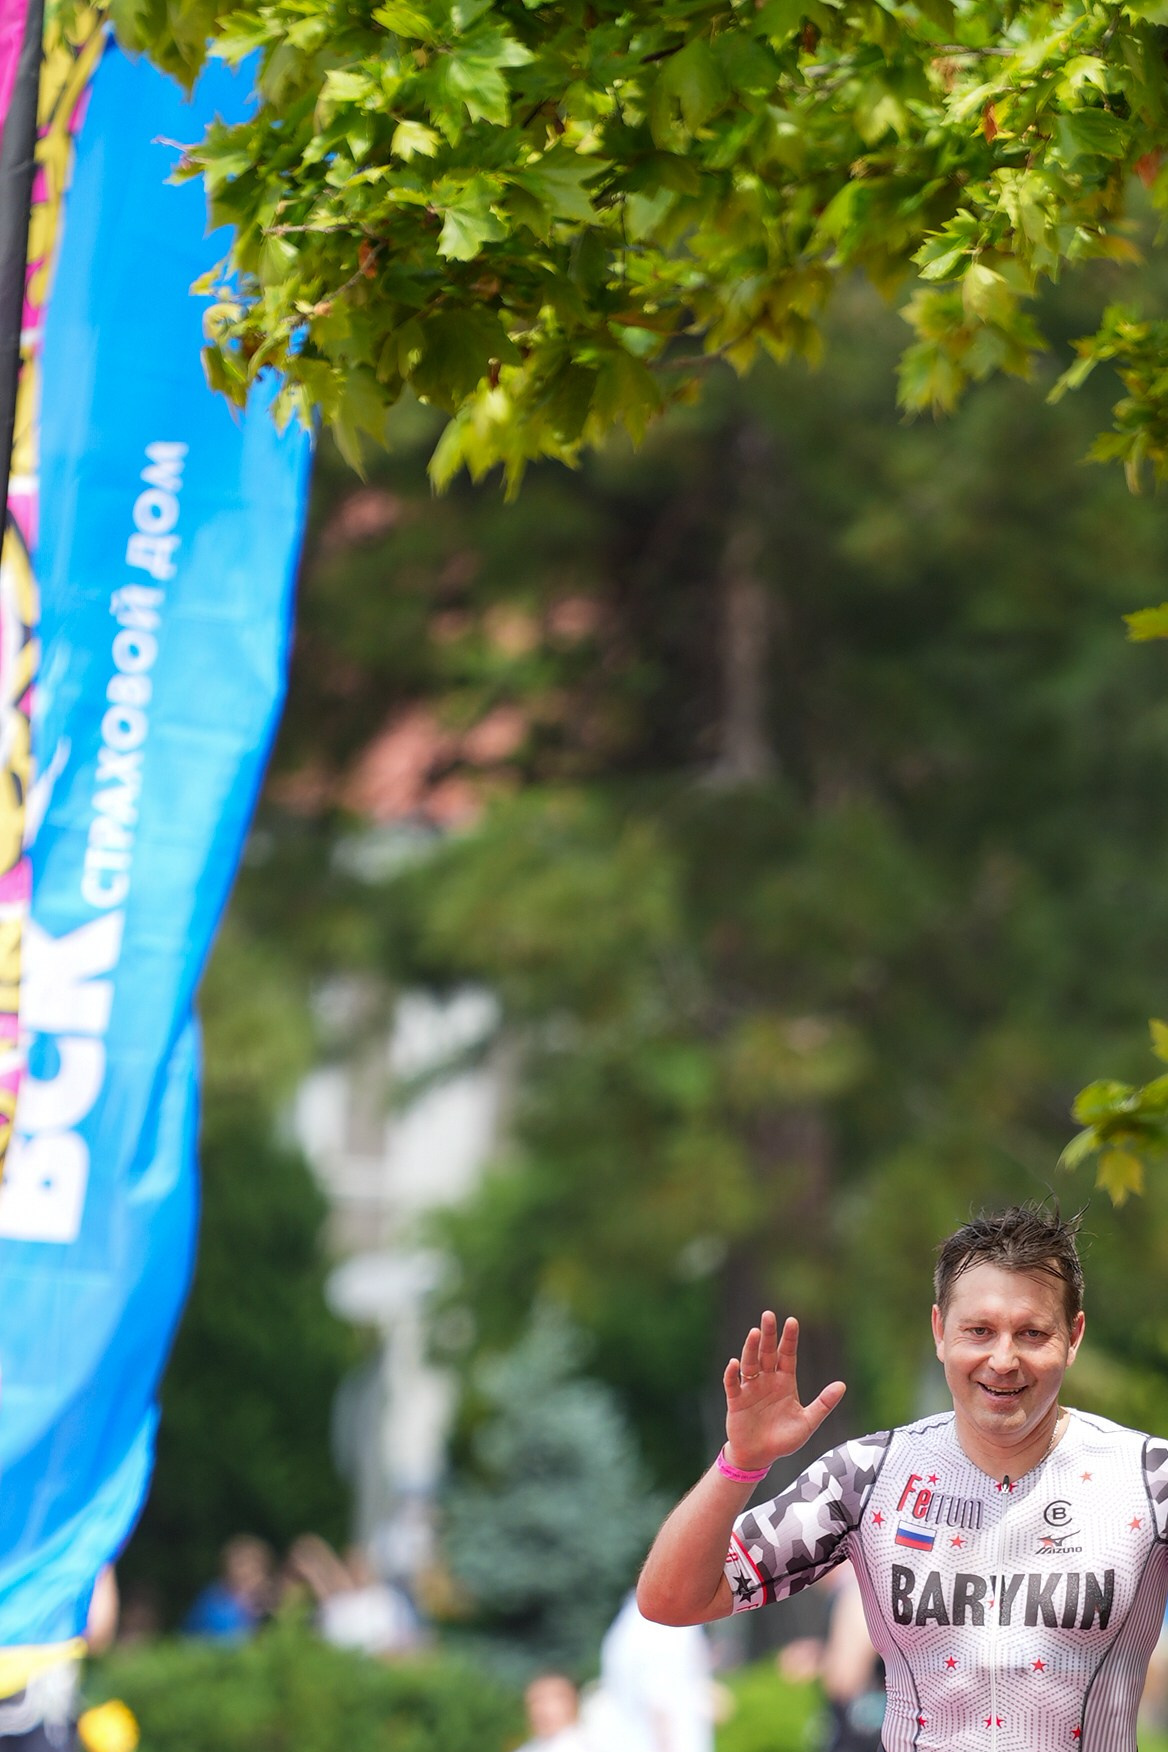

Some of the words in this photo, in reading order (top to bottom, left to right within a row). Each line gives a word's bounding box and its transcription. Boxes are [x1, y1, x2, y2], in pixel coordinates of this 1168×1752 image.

[82, 586, 165, 908] СТРАХОВОЙ
[126, 440, 190, 580] ДОМ
[897, 1473, 984, 1530] Ferrum
[892, 1563, 1115, 1630] BARYKIN
